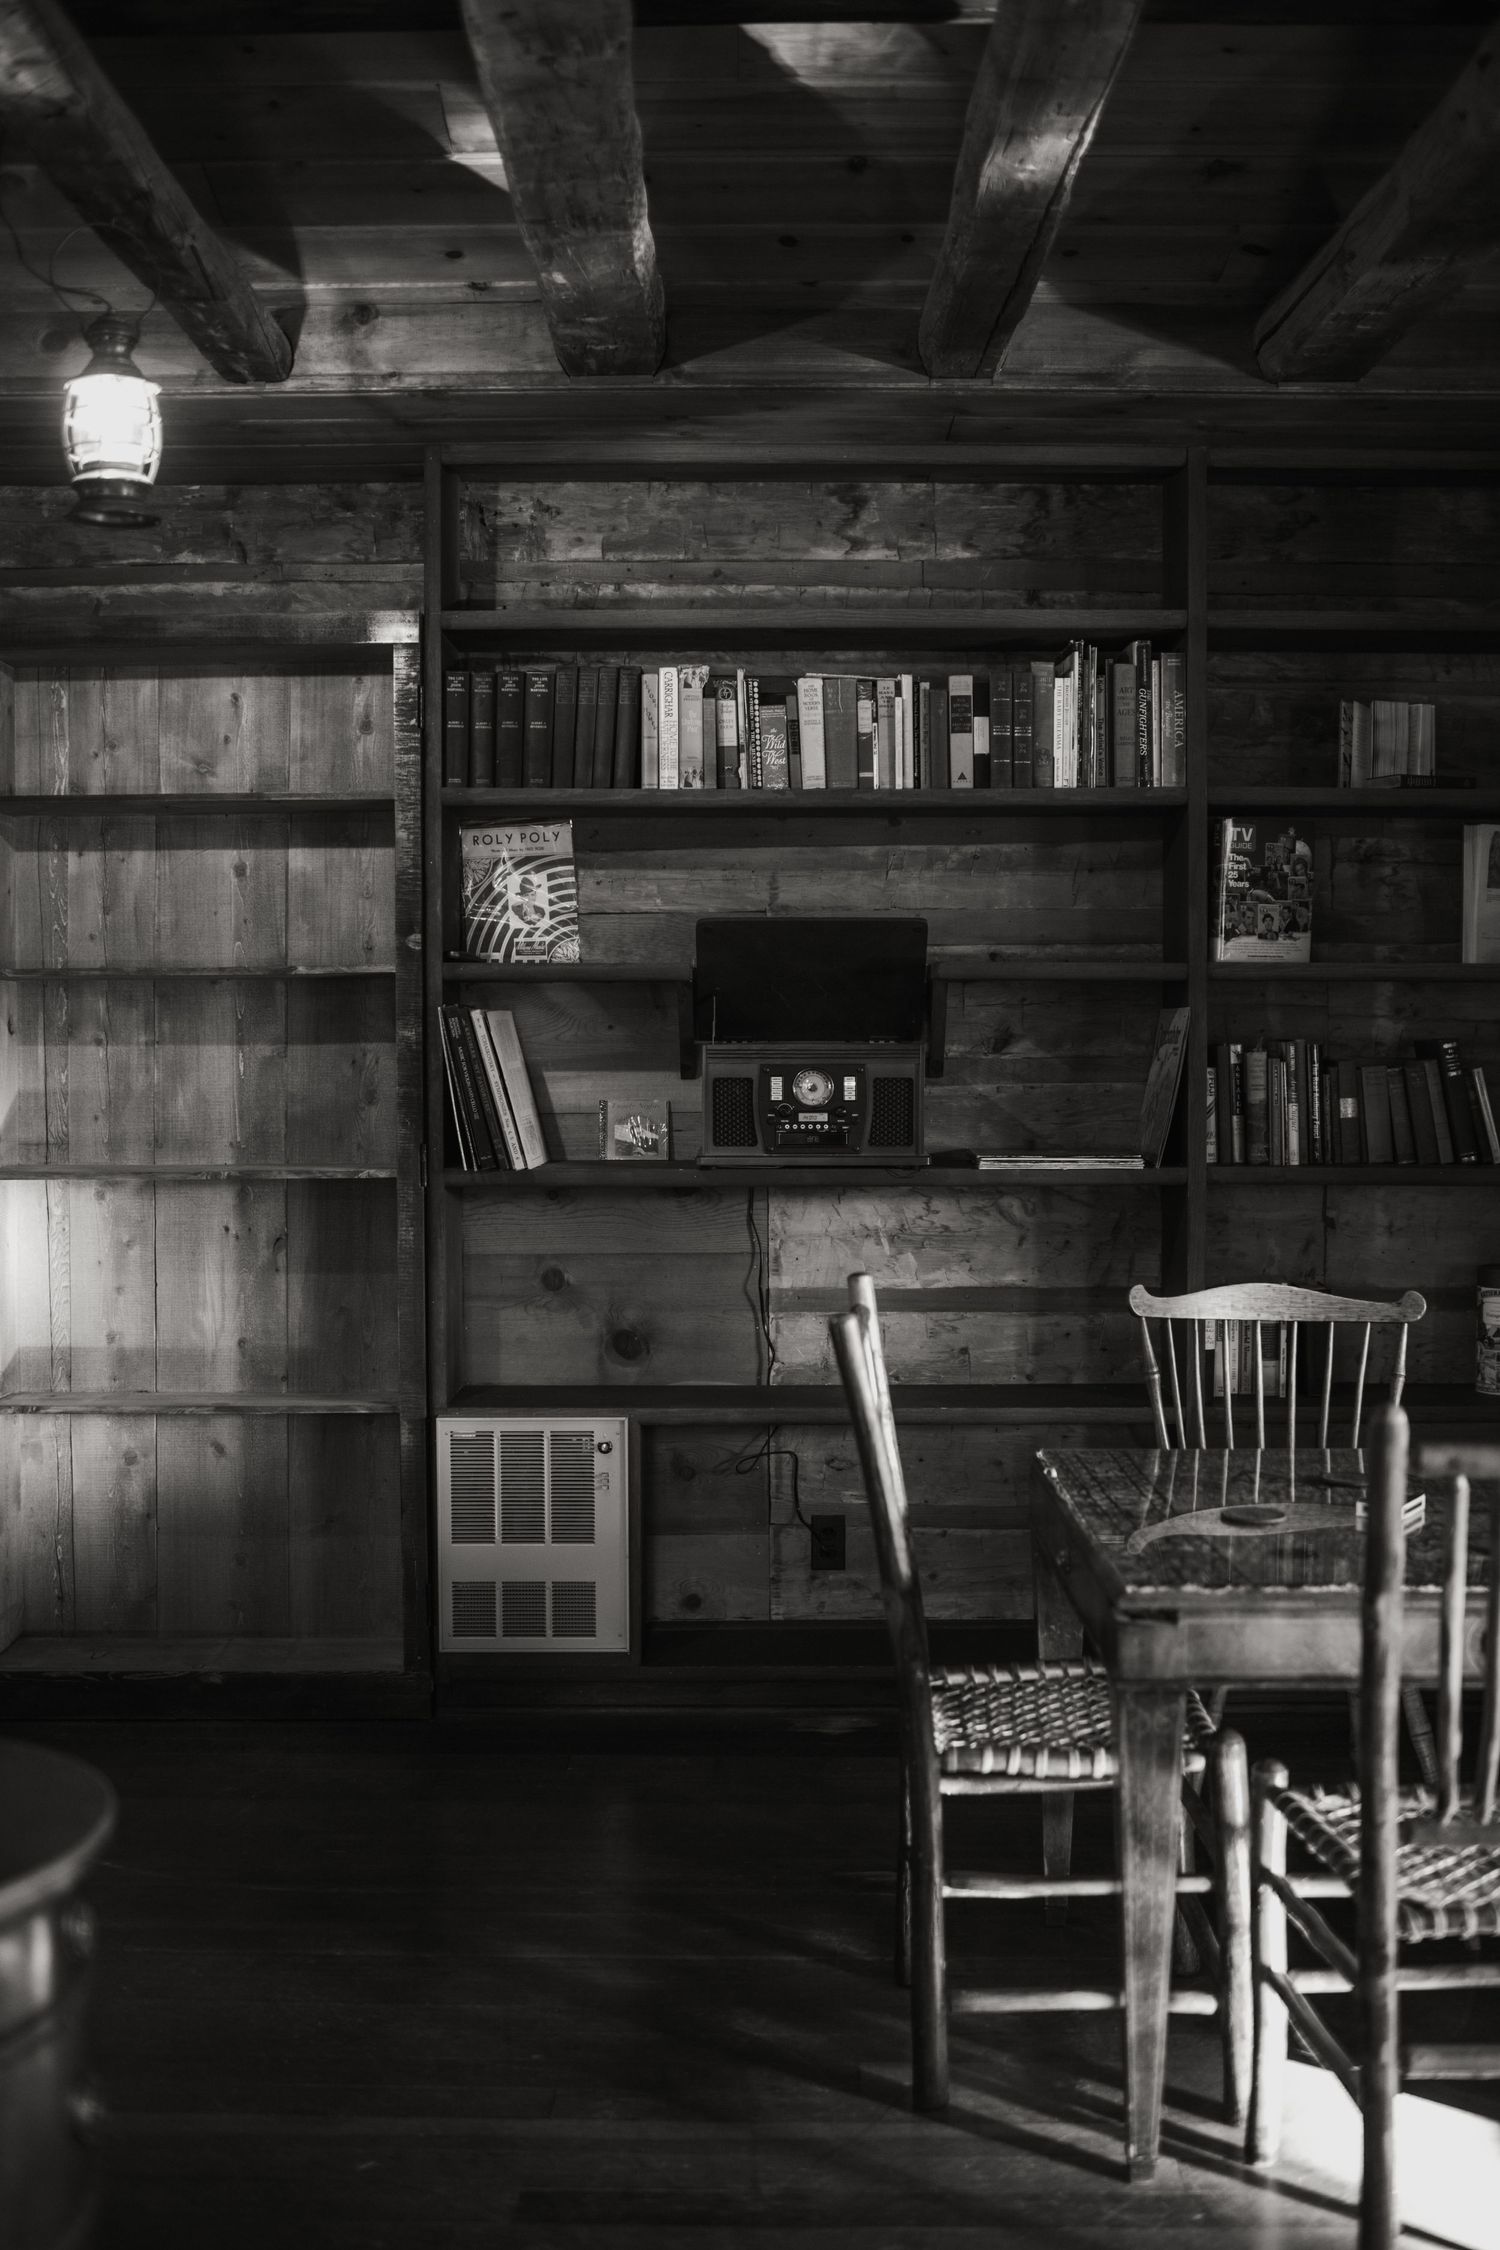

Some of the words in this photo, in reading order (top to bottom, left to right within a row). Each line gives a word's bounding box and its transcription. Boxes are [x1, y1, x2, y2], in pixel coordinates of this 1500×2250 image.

[664, 671, 674, 718] CARRIGHAR
[1139, 688, 1148, 756] GUNFIGHTERS
[1174, 690, 1184, 748] AMERICA
[761, 733, 786, 749] Wild
[762, 749, 786, 765] West
[473, 833, 513, 846] ROLY
[520, 831, 560, 843] POLY
[1231, 827, 1253, 842] TV
[1229, 853, 1245, 861] The
[1228, 862, 1247, 870] First
[1228, 871, 1239, 879] 25
[1228, 880, 1250, 888] Years
[480, 1034, 495, 1073] TCHAIKOVSKY
[494, 1081, 508, 1117] SYMPHONIES
[1311, 1092, 1320, 1119] Anthony
